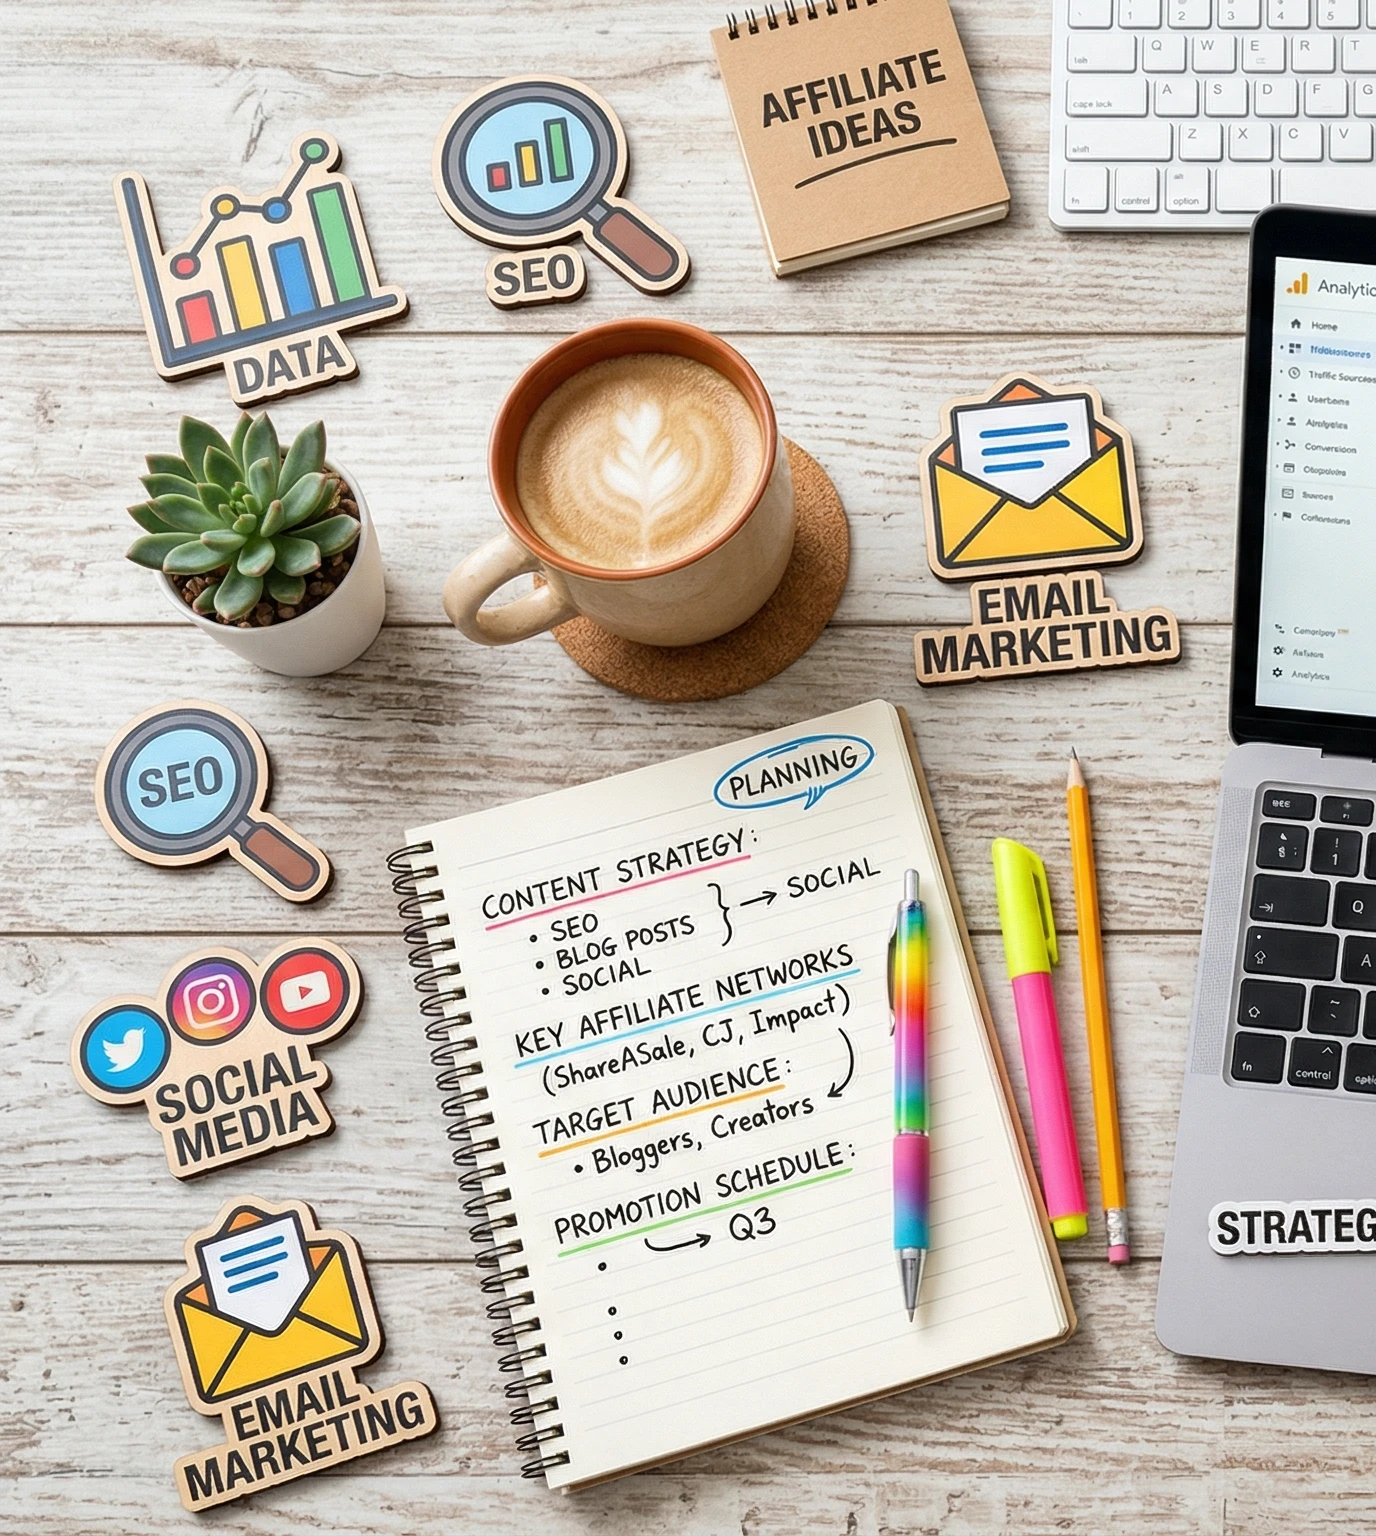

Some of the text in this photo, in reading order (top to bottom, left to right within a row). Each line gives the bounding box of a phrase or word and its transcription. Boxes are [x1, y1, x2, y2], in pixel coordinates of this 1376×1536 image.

[1127, 11, 1131, 20] 1
[1177, 10, 1185, 20] 2
[1227, 10, 1234, 20] 3
[1277, 11, 1283, 19] 4
[1326, 11, 1334, 20] 5
[1150, 39, 1162, 50] Q
[1200, 39, 1214, 50] W
[1250, 39, 1259, 51] E
[1299, 39, 1309, 51] R
[1349, 39, 1359, 50] T
[763, 48, 946, 128] AFFILIATE
[1162, 83, 1172, 94] A
[1213, 83, 1222, 94] S
[1262, 83, 1272, 94] D
[1312, 83, 1320, 94] F
[1362, 83, 1373, 95] G
[807, 100, 922, 158] IDEAS
[1187, 128, 1196, 139] Z
[1237, 127, 1247, 139] X
[1288, 127, 1298, 139] C
[1338, 128, 1348, 138] V
[494, 251, 573, 297] SEO
[232, 336, 347, 395] DATA
[978, 578, 1110, 626] EMAIL
[922, 615, 1172, 675] MARKETING
[138, 756, 223, 808] SEO
[728, 745, 859, 800] PLANNING
[482, 827, 759, 920] CONTENT STRATEGY:
[787, 857, 882, 899] SOCIAL
[1332, 853, 1337, 865] 1
[551, 913, 599, 942] SEO
[1352, 900, 1363, 914] Q
[556, 915, 695, 970] BLOG POSTS
[1360, 953, 1371, 967] A
[515, 943, 854, 1058] KEY AFFILIATE NETWORKS
[563, 959, 652, 996] SOCIAL
[542, 983, 852, 1097] (ShareASale, CJ, Impact)
[1242, 1062, 1251, 1072] fn
[156, 1045, 318, 1124] SOCIAL
[533, 1055, 794, 1146] TARGET AUDIENCE:
[173, 1091, 320, 1166] MEDIA
[592, 1095, 815, 1175] Bloggers, Creators
[554, 1140, 857, 1244] PROMOTION SCHEDULE:
[728, 1205, 778, 1242] Q3
[231, 1370, 361, 1441] EMAIL
[183, 1391, 425, 1501] MARKETING
